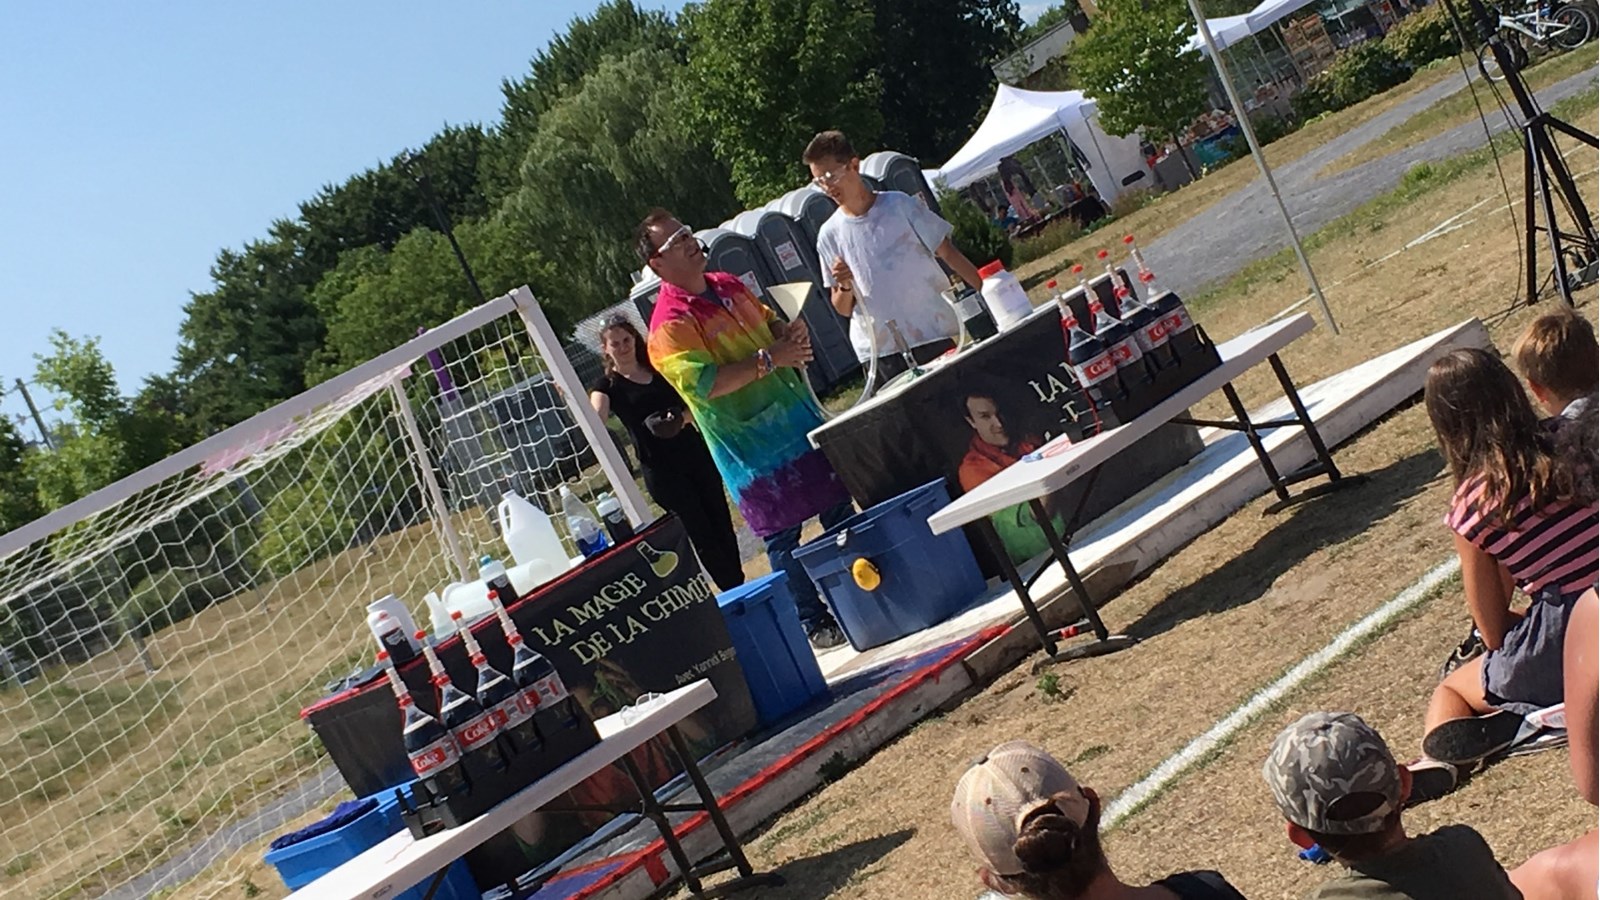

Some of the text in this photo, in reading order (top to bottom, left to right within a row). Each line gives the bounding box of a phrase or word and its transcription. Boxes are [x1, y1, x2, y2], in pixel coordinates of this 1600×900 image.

[1028, 373, 1069, 403] LA
[532, 572, 647, 646] LA MAGIE
[569, 631, 613, 666] DE
[606, 614, 649, 645] LA
[674, 669, 696, 685] Avec
[464, 720, 492, 742] Coke
[413, 753, 439, 770] Coke
